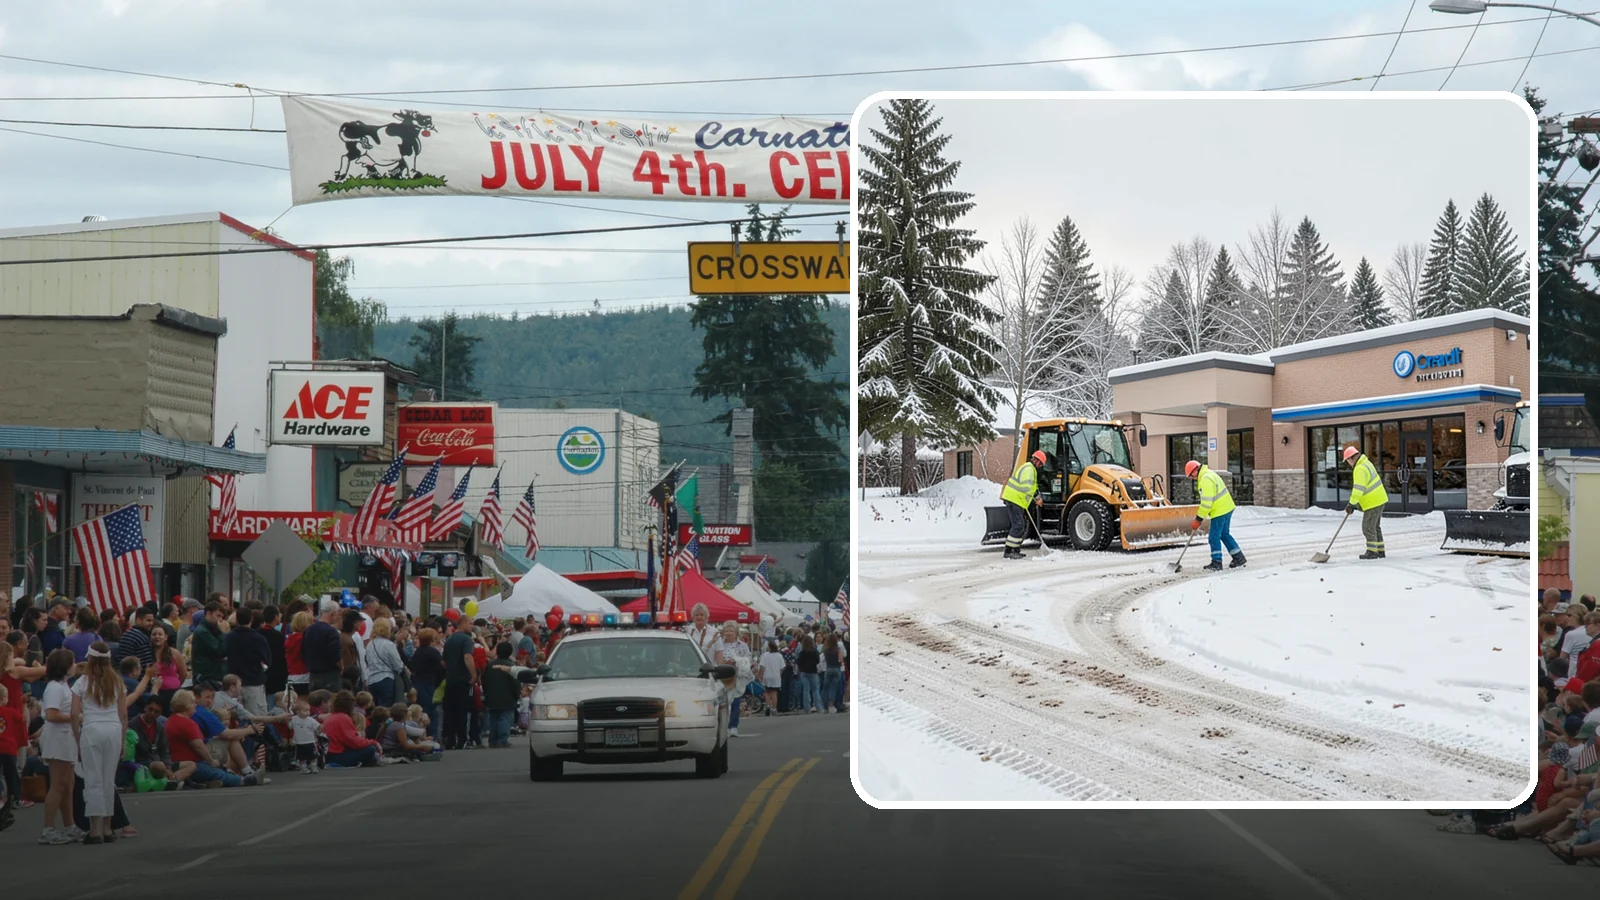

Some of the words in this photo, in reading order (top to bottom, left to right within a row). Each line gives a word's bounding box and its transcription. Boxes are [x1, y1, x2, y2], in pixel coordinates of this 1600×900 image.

[481, 140, 605, 193] JULY
[632, 150, 746, 198] 4th.
[697, 254, 850, 280] CROSSWA
[283, 380, 373, 420] ACE
[406, 409, 452, 422] CEDAR
[460, 409, 485, 422] LOG
[283, 421, 371, 436] Hardware
[416, 428, 477, 447] Coca-Cola
[95, 484, 124, 495] Vincent
[126, 485, 136, 495] de
[137, 485, 155, 495] Paul
[81, 503, 154, 522] THT
[688, 526, 741, 535] CRNATION
[699, 535, 730, 543] GLASS
